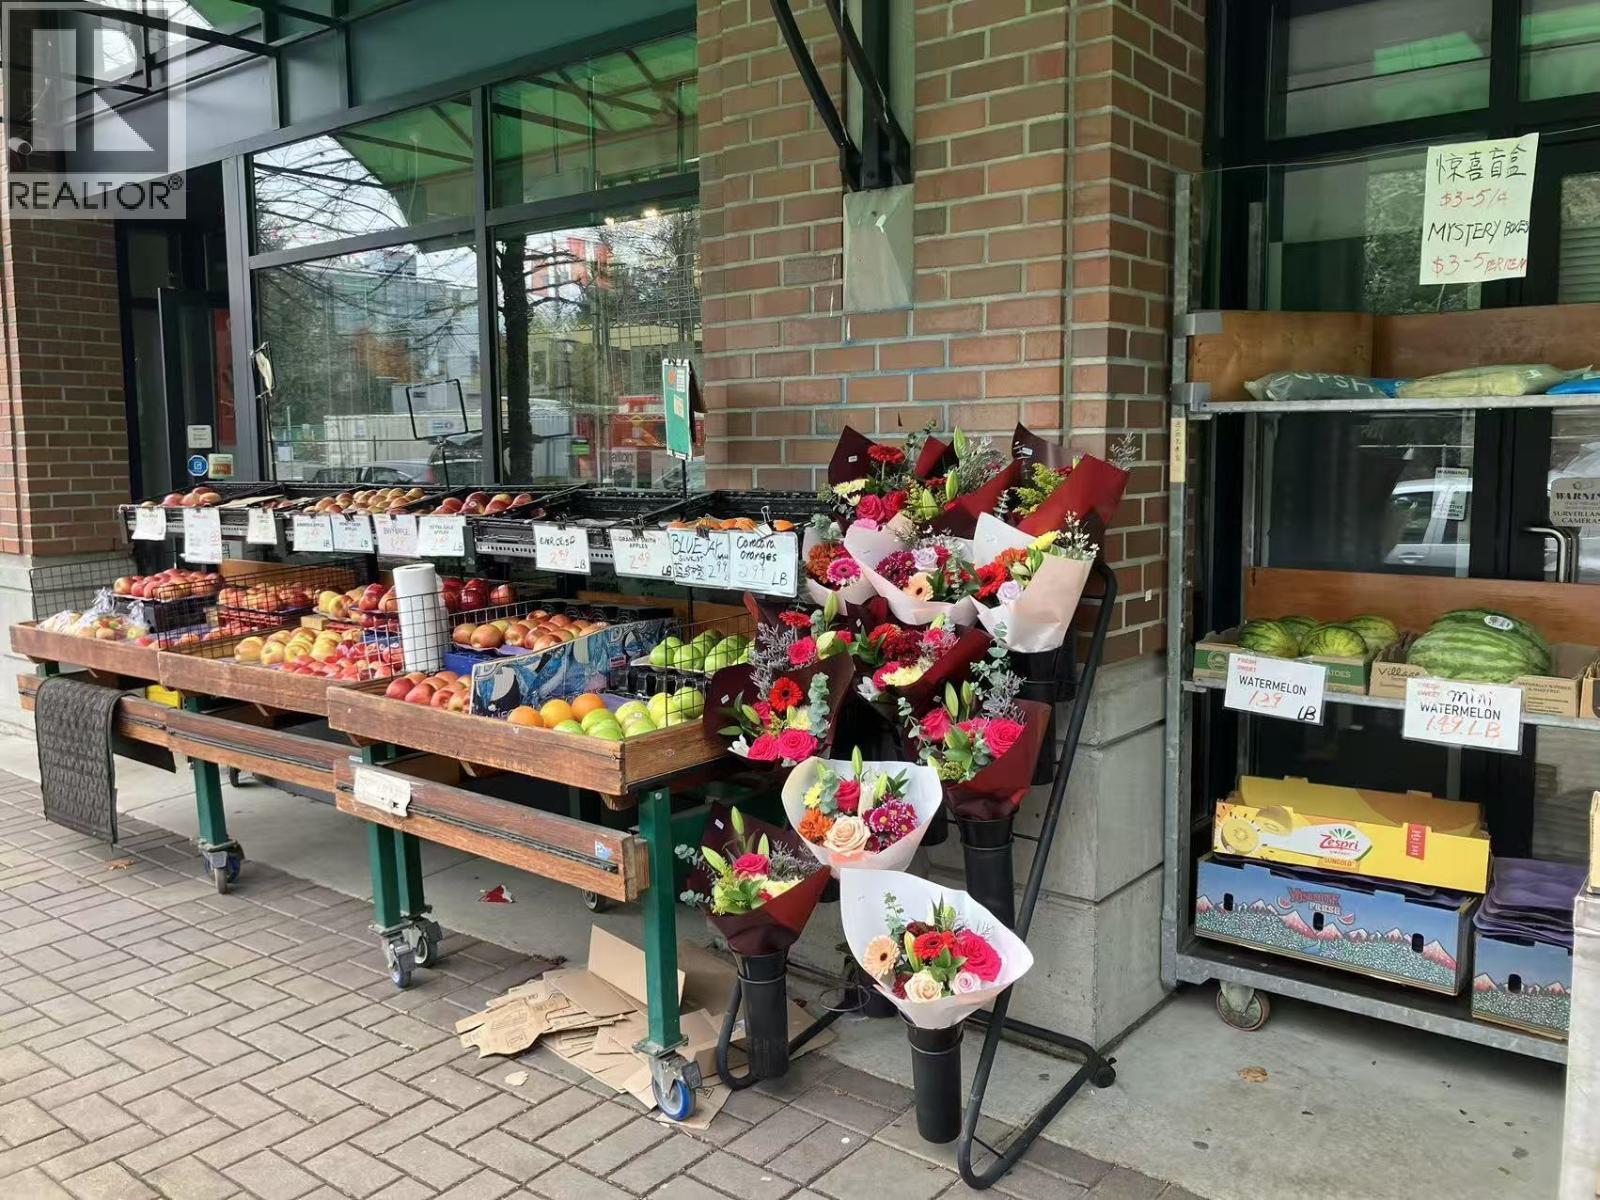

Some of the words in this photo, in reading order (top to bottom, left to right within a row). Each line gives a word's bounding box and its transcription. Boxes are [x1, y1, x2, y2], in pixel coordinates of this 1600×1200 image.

[1428, 220, 1501, 247] MYSTERY
[1556, 492, 1600, 500] WARNI
[671, 533, 701, 555] BLUE
[661, 565, 672, 577] LB
[771, 572, 788, 586] LB
[1239, 675, 1307, 696] WATERMELON
[1447, 688, 1493, 706] mini
[1420, 703, 1501, 721] WATERMELON
[1320, 833, 1360, 851] Zespri
